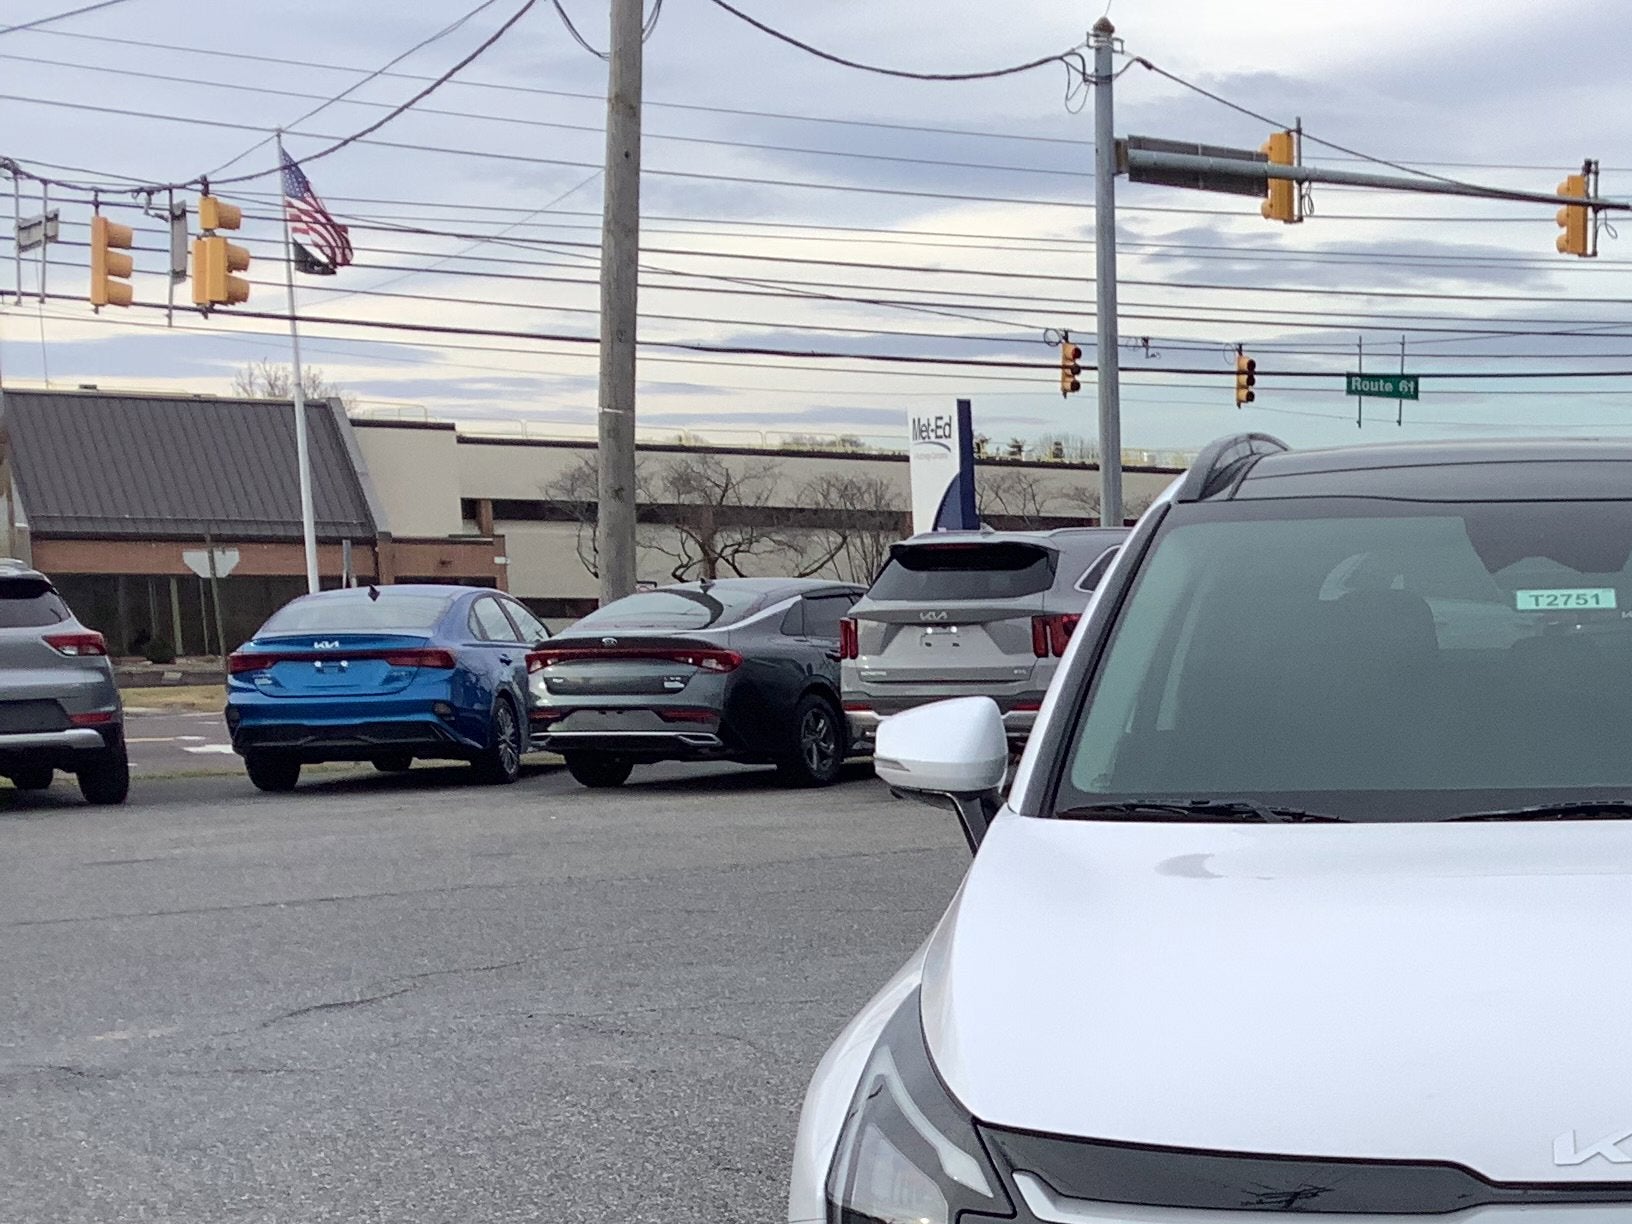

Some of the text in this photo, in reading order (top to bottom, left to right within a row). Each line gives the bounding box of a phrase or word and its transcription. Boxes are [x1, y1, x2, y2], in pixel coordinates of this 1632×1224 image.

[1351, 377, 1415, 394] Route 61
[912, 415, 952, 440] Met-Ed
[1529, 593, 1601, 607] T2751
